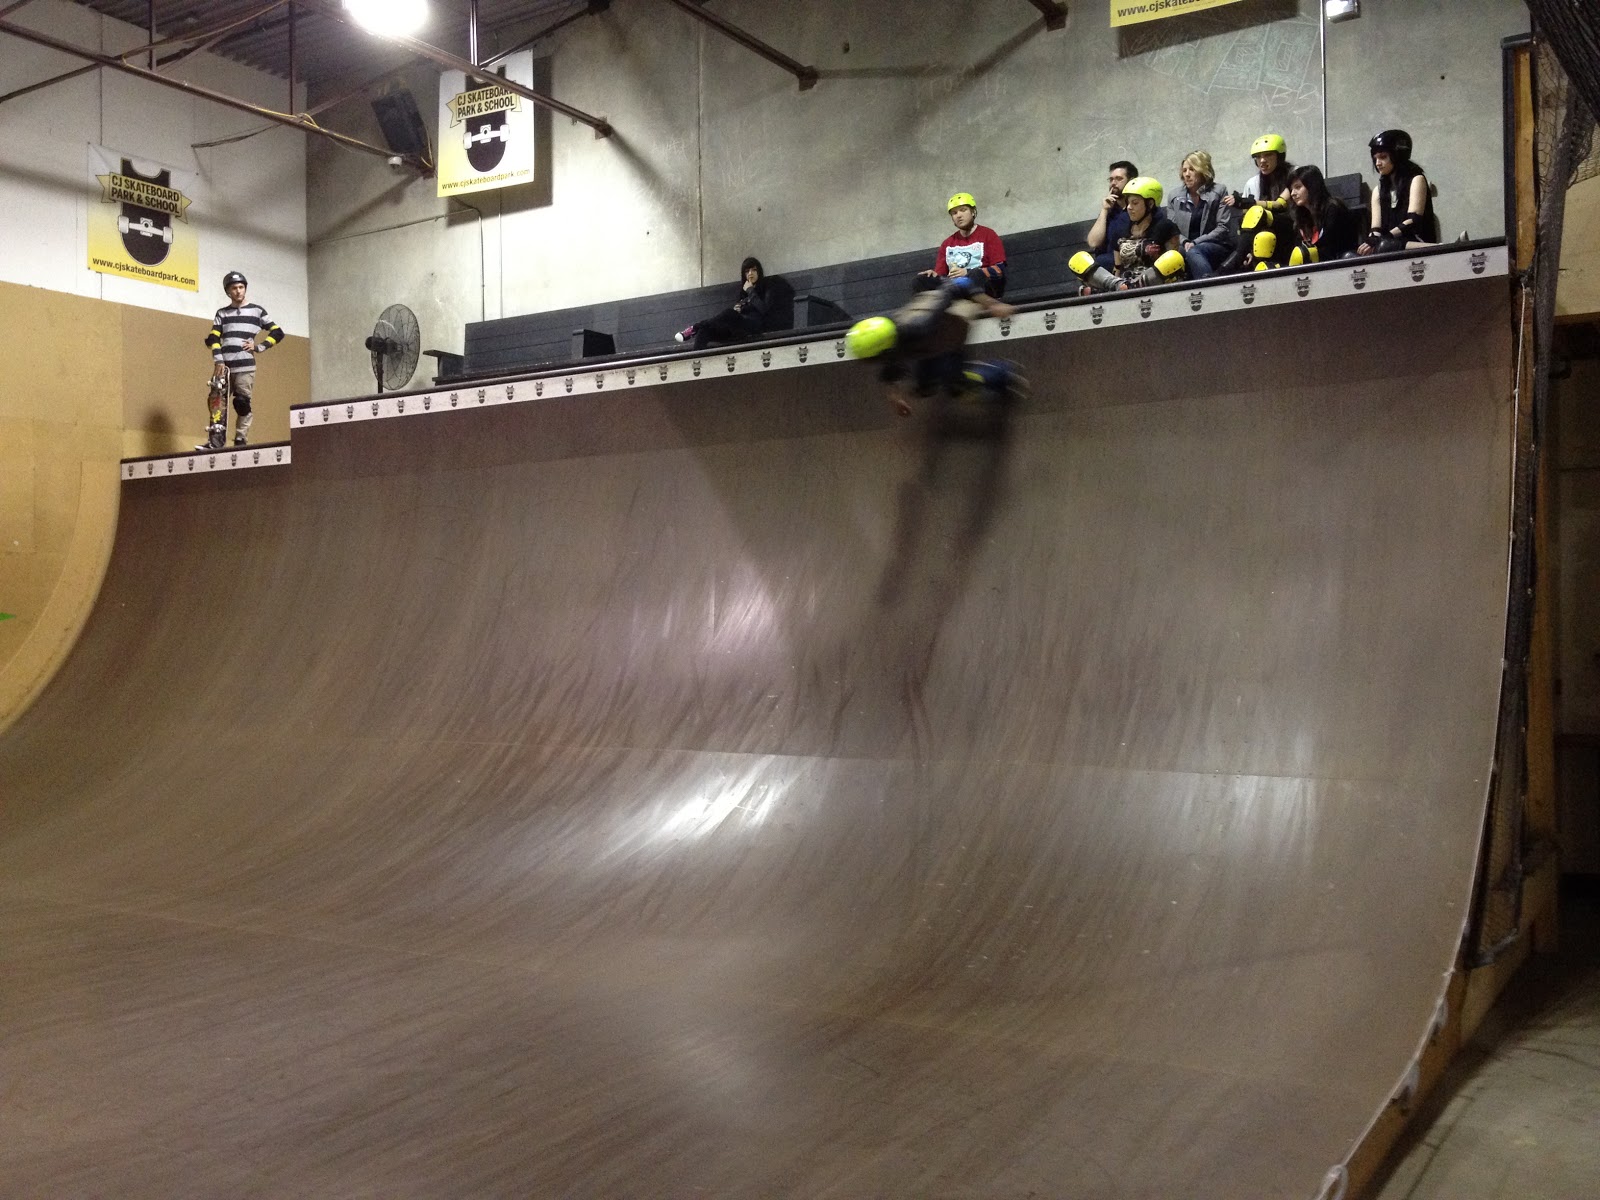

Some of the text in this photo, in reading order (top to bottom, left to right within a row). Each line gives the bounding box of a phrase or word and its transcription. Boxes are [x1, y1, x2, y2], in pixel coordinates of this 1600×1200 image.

[457, 95, 466, 106] CJ
[457, 96, 515, 118] PARK & SCHOOL
[111, 175, 179, 202] CJ SKATEBOARD
[111, 187, 179, 213] PARK & SCHOOL
[92, 258, 196, 286] www.cjskateboardpark.com
